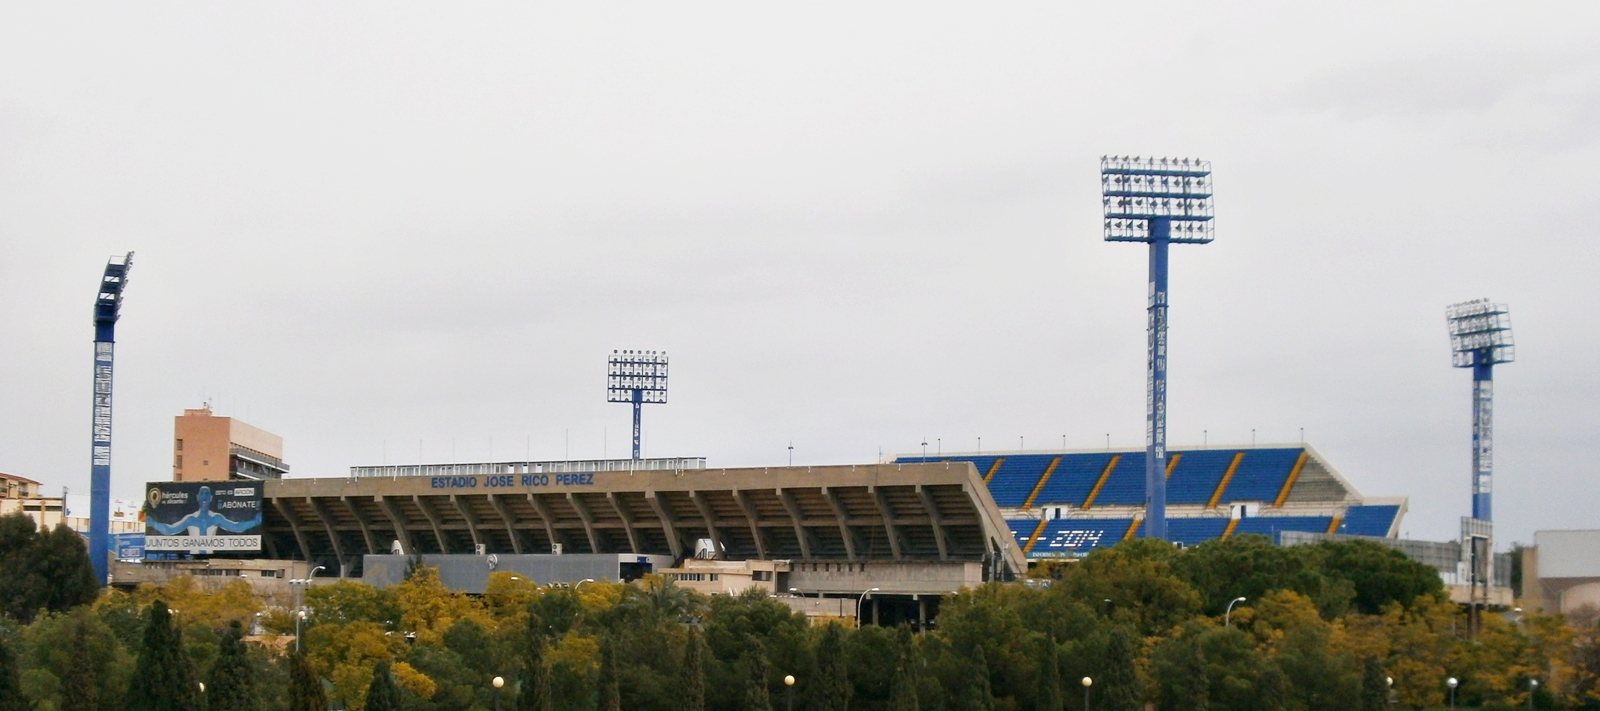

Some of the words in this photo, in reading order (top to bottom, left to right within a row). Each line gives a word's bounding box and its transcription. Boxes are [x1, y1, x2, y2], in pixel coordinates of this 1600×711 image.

[431, 476, 477, 488] ESTADIO
[483, 475, 514, 487] JOSE
[521, 474, 549, 486] RICO
[556, 473, 594, 485] PEREZ
[146, 538, 179, 548] JUNTOS
[182, 538, 225, 548] GANAMOS
[228, 538, 258, 547] TODOS
